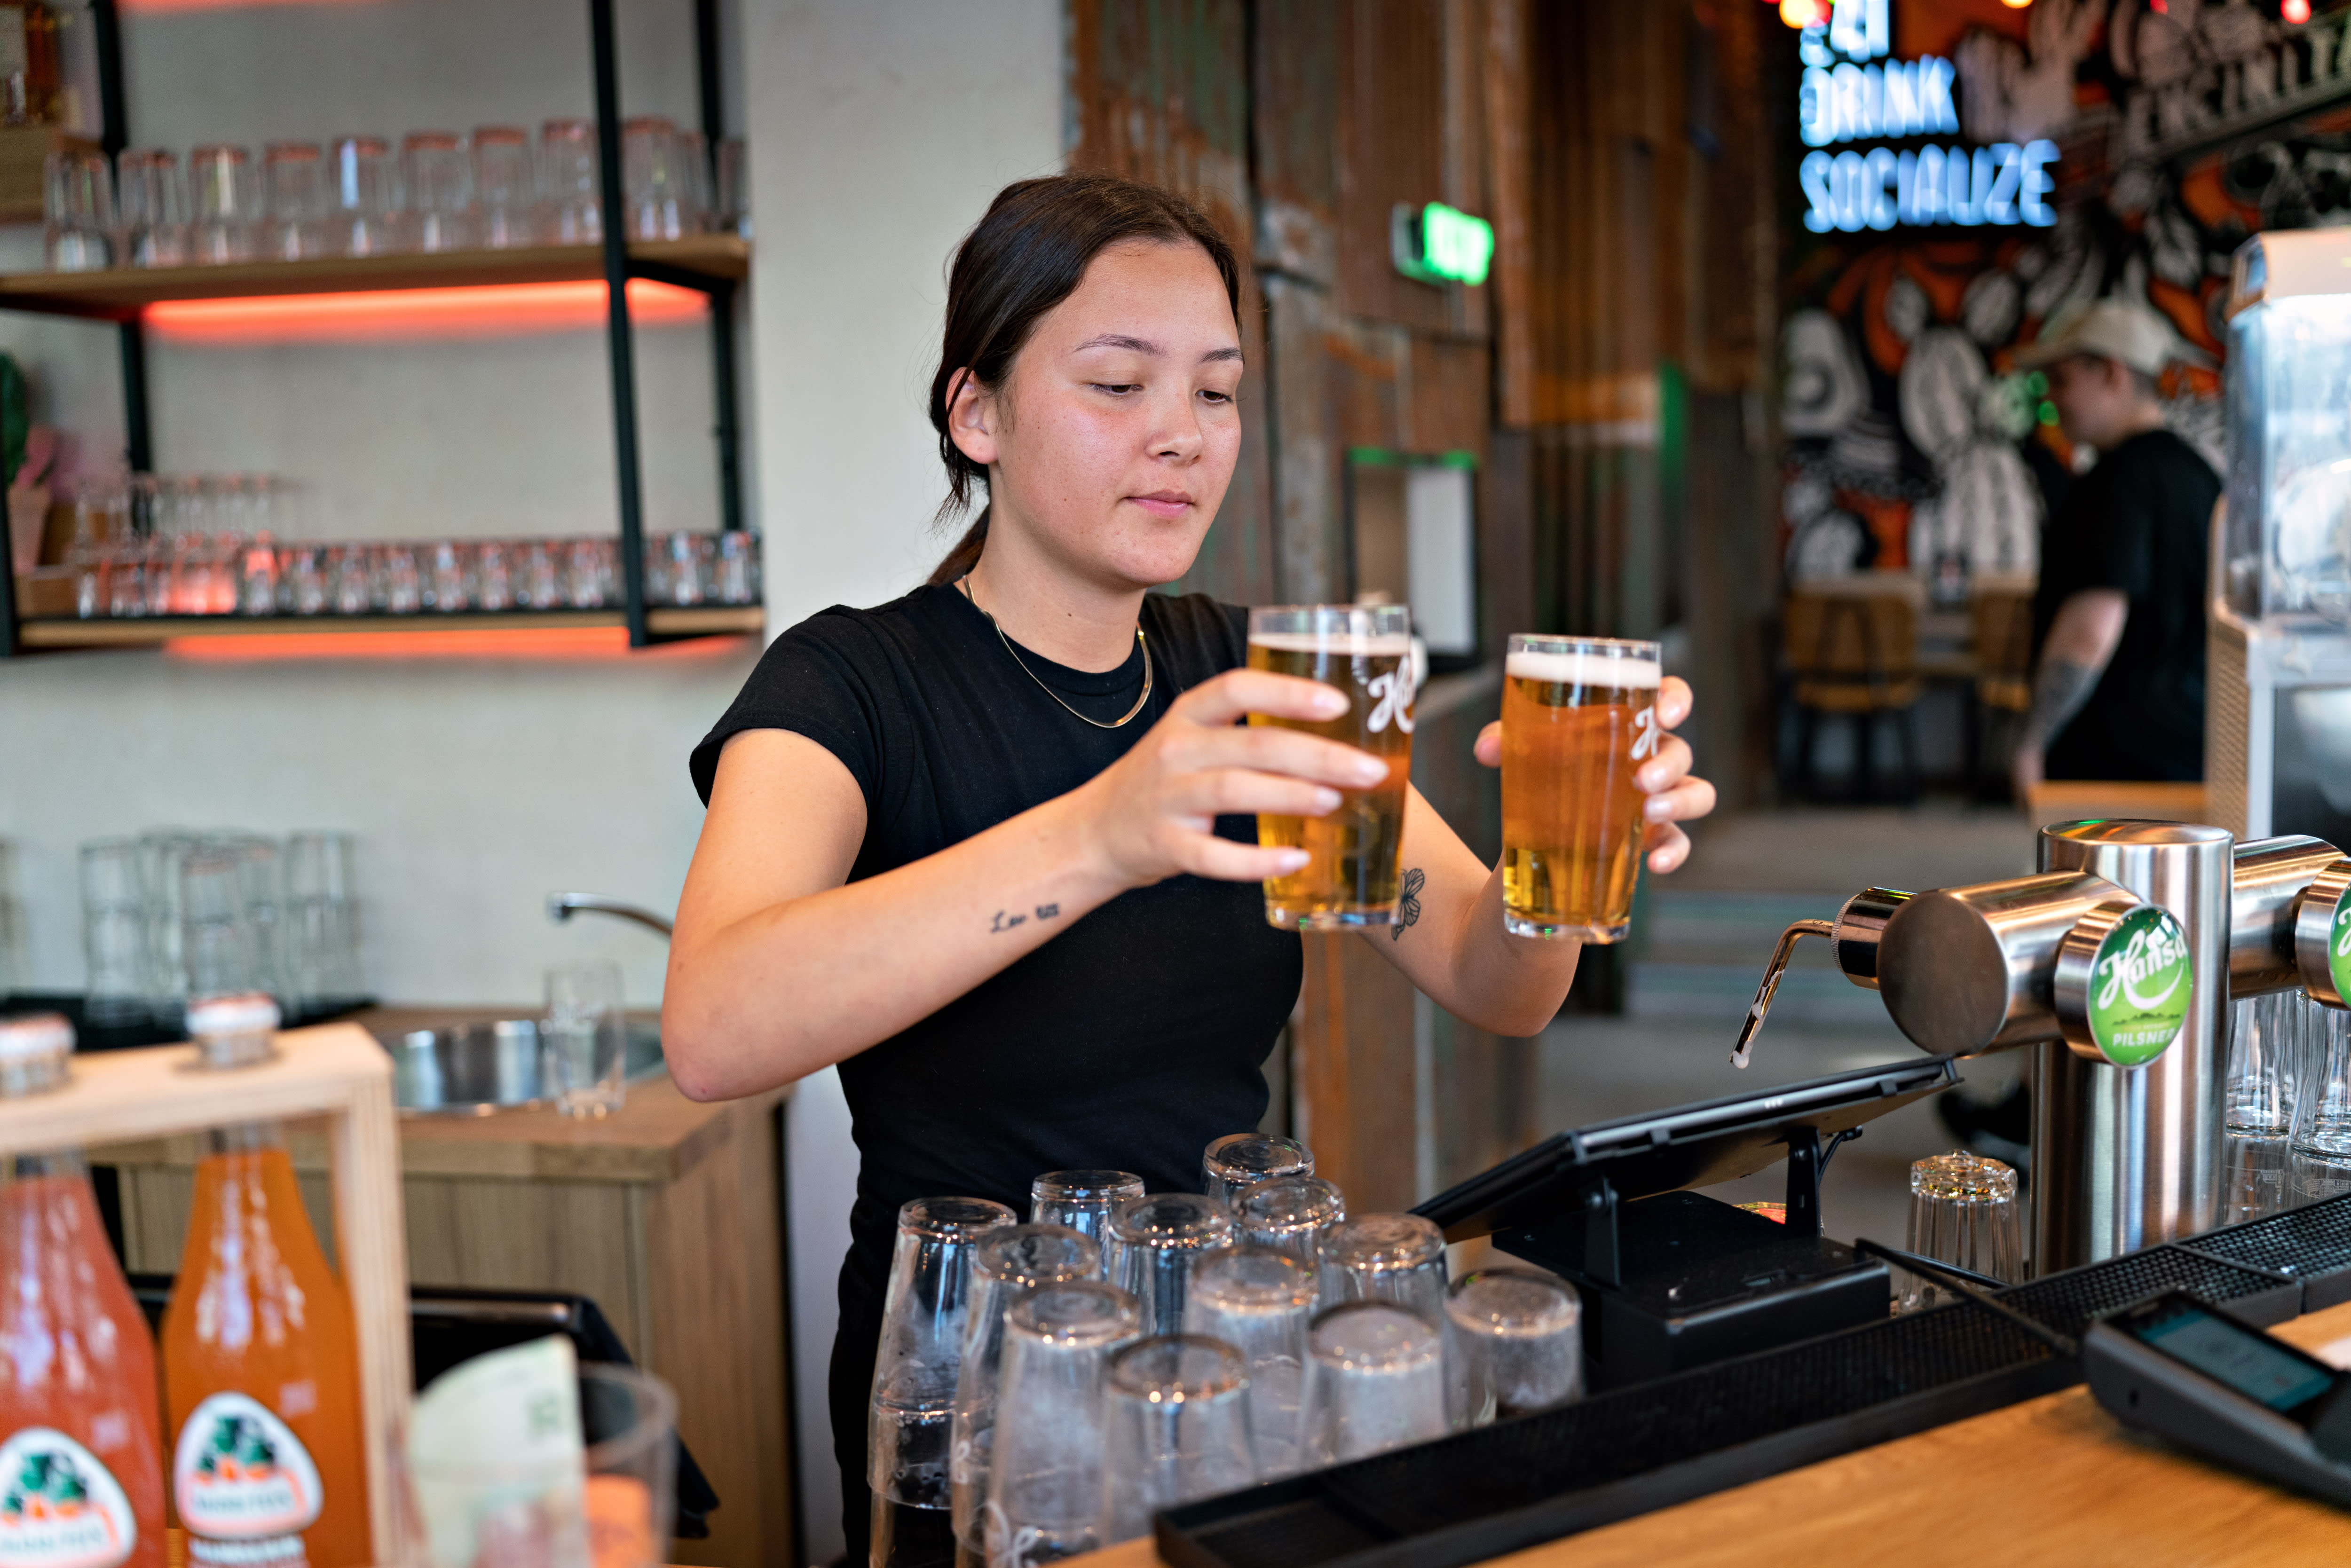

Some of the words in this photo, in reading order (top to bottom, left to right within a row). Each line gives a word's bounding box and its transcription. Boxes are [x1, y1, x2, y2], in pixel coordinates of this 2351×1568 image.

[1800, 54, 1959, 147] DRINK
[1800, 140, 2061, 233] SOCIALIZE
[2098, 926, 2187, 1011] Hansa
